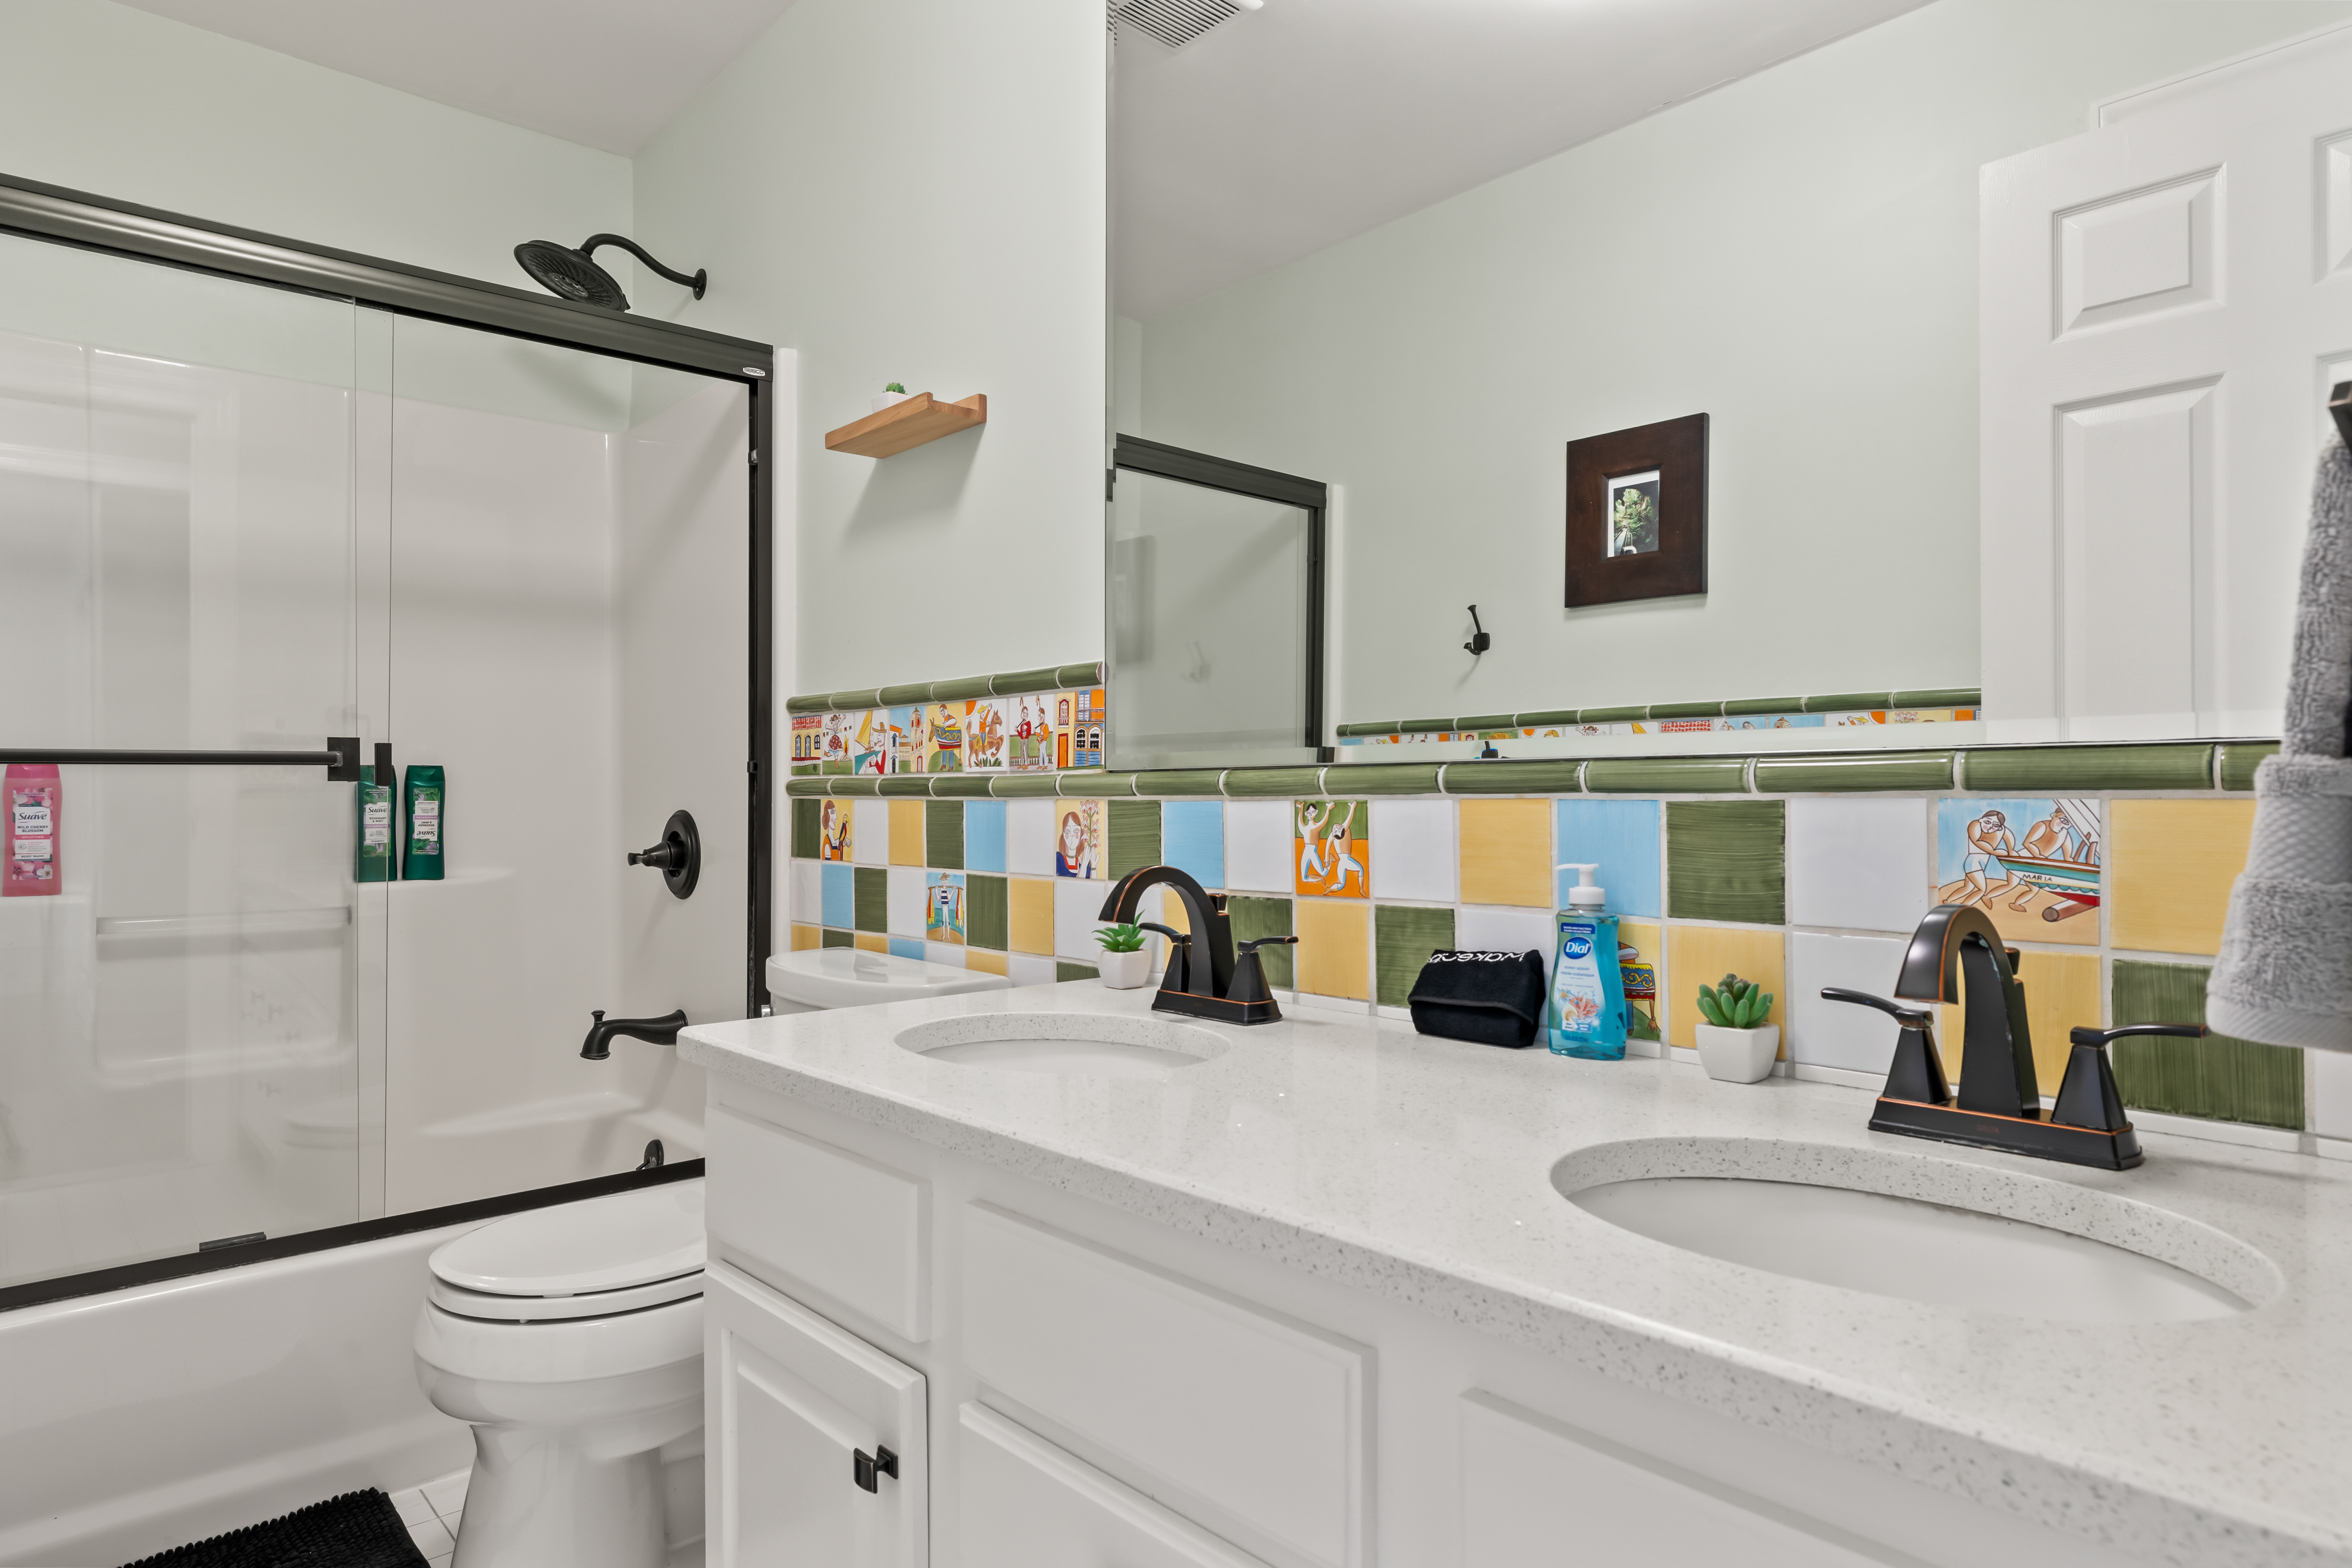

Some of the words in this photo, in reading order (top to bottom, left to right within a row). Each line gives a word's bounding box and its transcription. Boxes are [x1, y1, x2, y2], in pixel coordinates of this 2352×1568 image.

[18, 812, 47, 821] Suave
[2022, 874, 2052, 882] MARIA
[1565, 942, 1589, 954] Dial
[1976, 1124, 2000, 1134] DELTA
